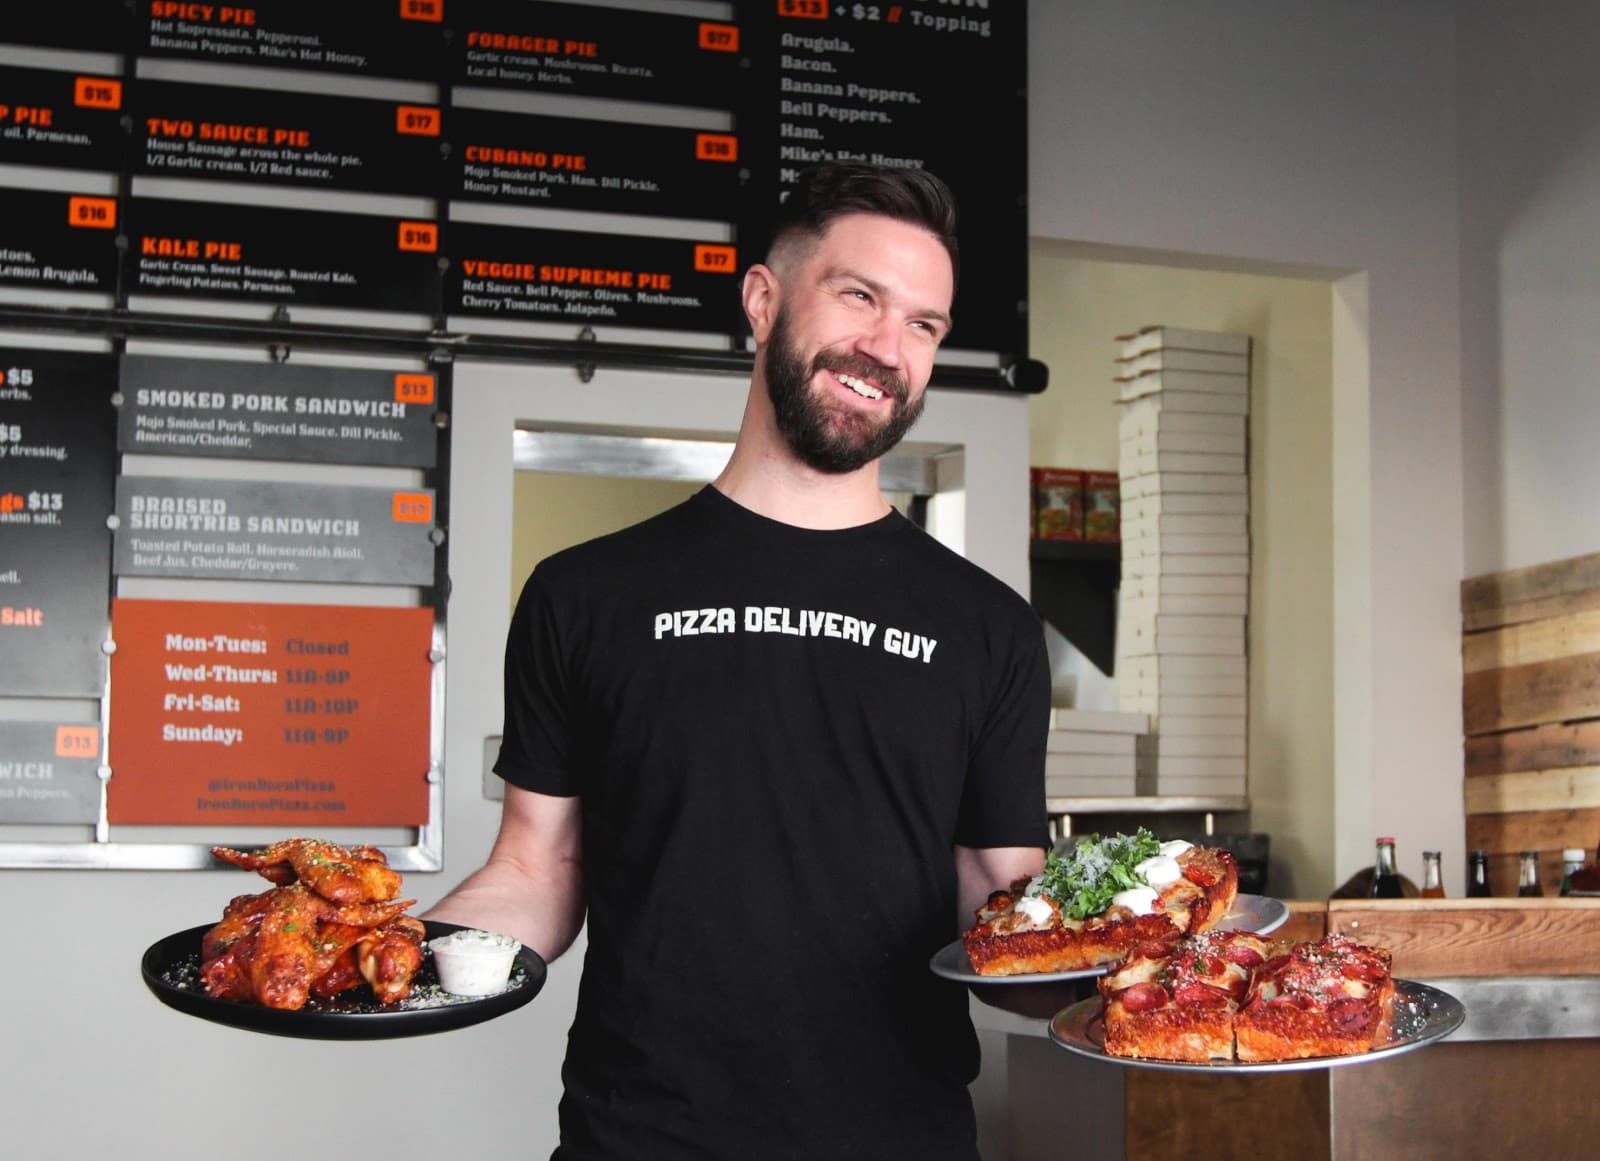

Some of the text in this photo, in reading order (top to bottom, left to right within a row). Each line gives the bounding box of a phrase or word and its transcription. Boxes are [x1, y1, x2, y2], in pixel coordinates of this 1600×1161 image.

[151, 2, 256, 26] SPICY PIE
[852, 3, 880, 21] $2
[911, 10, 991, 37] Topping
[151, 20, 173, 32] Hot
[256, 29, 322, 46] Pepperoni.
[781, 33, 855, 53] Arugula.
[150, 35, 198, 50] Banana
[201, 40, 256, 55] Peppers.
[260, 45, 297, 59] Mike's
[301, 48, 322, 61] Hot
[467, 32, 597, 57] FORAGER PIE
[467, 51, 500, 64] Garlic
[781, 55, 837, 73] Bacon.
[467, 65, 497, 77] Local
[781, 77, 921, 104] Banana Peppers.
[15, 106, 52, 126] PIE
[406, 113, 432, 129] $17
[781, 100, 893, 123] Bell Peppers.
[27, 127, 92, 145] Parmesan.
[147, 117, 309, 147] TWO SAUCE PIE
[780, 123, 824, 140] Ham.
[147, 138, 362, 168] House Sausage across the whole pie.
[465, 146, 586, 171] CUBANO PIE
[147, 154, 333, 179] 1/2 Garlic cream. 1/2 Red sauce.
[464, 164, 490, 178] Mojo
[492, 167, 536, 182] Smoked
[601, 176, 620, 189] Dill
[623, 178, 660, 192] Pickle.
[464, 180, 552, 198] Honey Mustard.
[79, 205, 107, 220] $16
[405, 230, 431, 244] $16
[142, 237, 242, 260] KALE PIE
[703, 252, 729, 267] $17
[43, 266, 98, 284] Arugula.
[140, 259, 169, 271] Garlic
[210, 264, 241, 275] Sweet
[290, 270, 330, 282] Roasted
[463, 260, 671, 290] VEGGIE SUPREME PIE
[140, 273, 295, 294] Fingerling Potatoes. Parmesan.
[463, 279, 702, 307] Red Sauce. Bell Pepper. Olives. Mushrooms.
[462, 295, 501, 311] Cherry
[504, 298, 561, 314] Tomatoes.
[7, 367, 34, 387] $5
[137, 389, 406, 418] SMOKED PORK SANDWICH
[137, 415, 403, 442] Mojo Smoked Pork. Special Sauce. Dill Pickle.
[28, 490, 63, 511] $13
[131, 496, 226, 515] BRAISED
[33, 512, 62, 526] salt.
[130, 513, 360, 536] SHORTRIB SANDWICH
[131, 539, 180, 553] Toasted
[183, 540, 224, 553] Potato
[227, 542, 254, 555] Roll.
[257, 543, 330, 559] Horseradish
[134, 554, 162, 566] Beef
[2, 607, 43, 627] Salt
[165, 634, 350, 656] Mon-Tues: Closed
[654, 606, 938, 664] PIZZA DELIVERY GUY
[164, 664, 278, 684] Wed-Thurs:
[163, 693, 241, 713] Fri-Sat:
[163, 723, 244, 746] Sunday:
